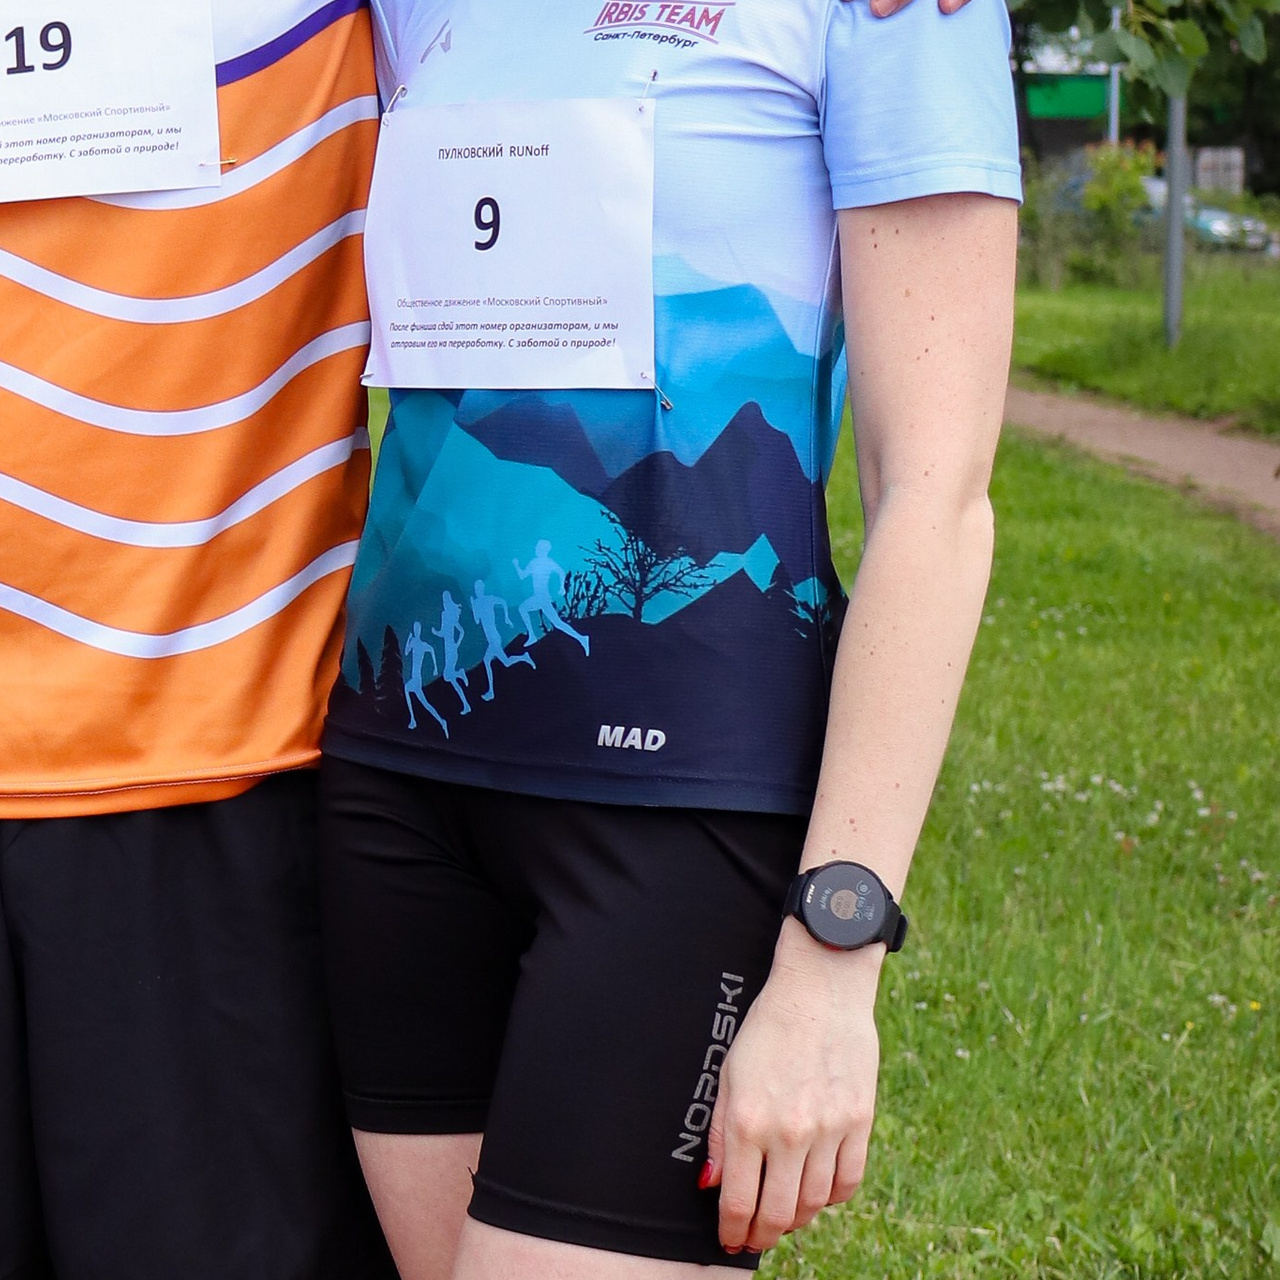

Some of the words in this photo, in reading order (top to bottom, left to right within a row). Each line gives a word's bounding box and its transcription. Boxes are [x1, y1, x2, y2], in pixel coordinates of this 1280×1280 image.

[593, 0, 649, 29] IRBIS
[654, 2, 727, 38] TEAM
[4, 20, 73, 76] 19
[593, 30, 699, 50] Санкт-Петербург
[37, 107, 102, 123] «Московский
[104, 102, 172, 117] Спортивный»
[4, 138, 34, 149] этот
[36, 134, 68, 146] номер
[69, 127, 155, 143] организаторам,
[165, 126, 182, 134] мы
[77, 144, 123, 158] заботой
[133, 141, 179, 155] природе!
[437, 142, 504, 160] ПУЛКОВСКИЙ
[508, 143, 551, 158] RUNoff
[473, 196, 502, 251] 9
[482, 296, 541, 307] «Московский
[543, 295, 608, 308] Спортивный»
[389, 322, 409, 332] После
[437, 321, 454, 331] сдай
[454, 323, 478, 331] этот
[480, 323, 508, 332] номер
[509, 323, 591, 332] организаторам,
[438, 340, 448, 348] на
[448, 337, 506, 350] переработку.
[508, 338, 515, 348] С
[516, 337, 560, 348] заботой
[570, 337, 616, 349] природе!
[597, 724, 666, 752] MAD
